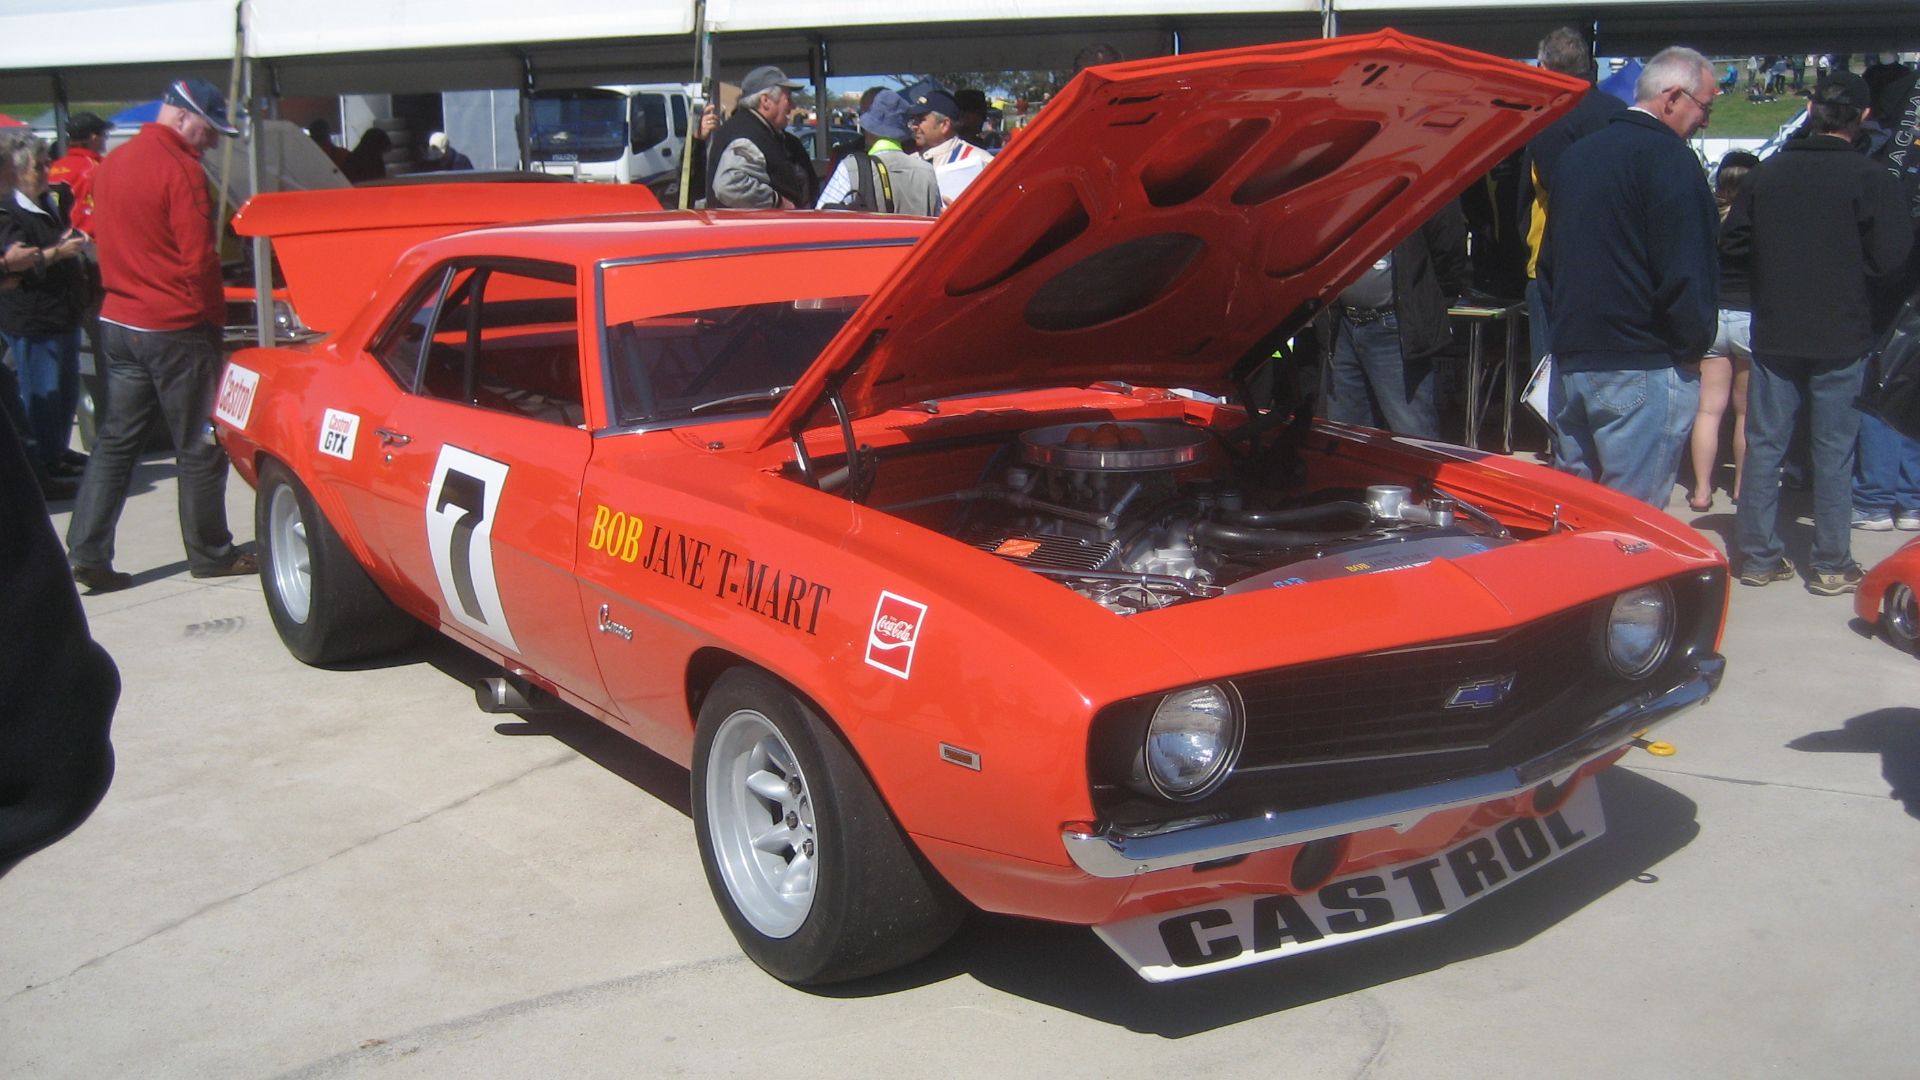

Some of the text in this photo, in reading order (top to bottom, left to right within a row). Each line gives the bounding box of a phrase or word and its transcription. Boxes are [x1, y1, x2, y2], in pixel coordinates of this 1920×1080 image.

[219, 369, 257, 422] Castrol
[328, 414, 352, 434] Castrol
[324, 431, 348, 455] GTX
[436, 467, 488, 626] 7
[588, 504, 831, 636] BOB JANE T-MART
[1158, 810, 1587, 968] CASTROL
